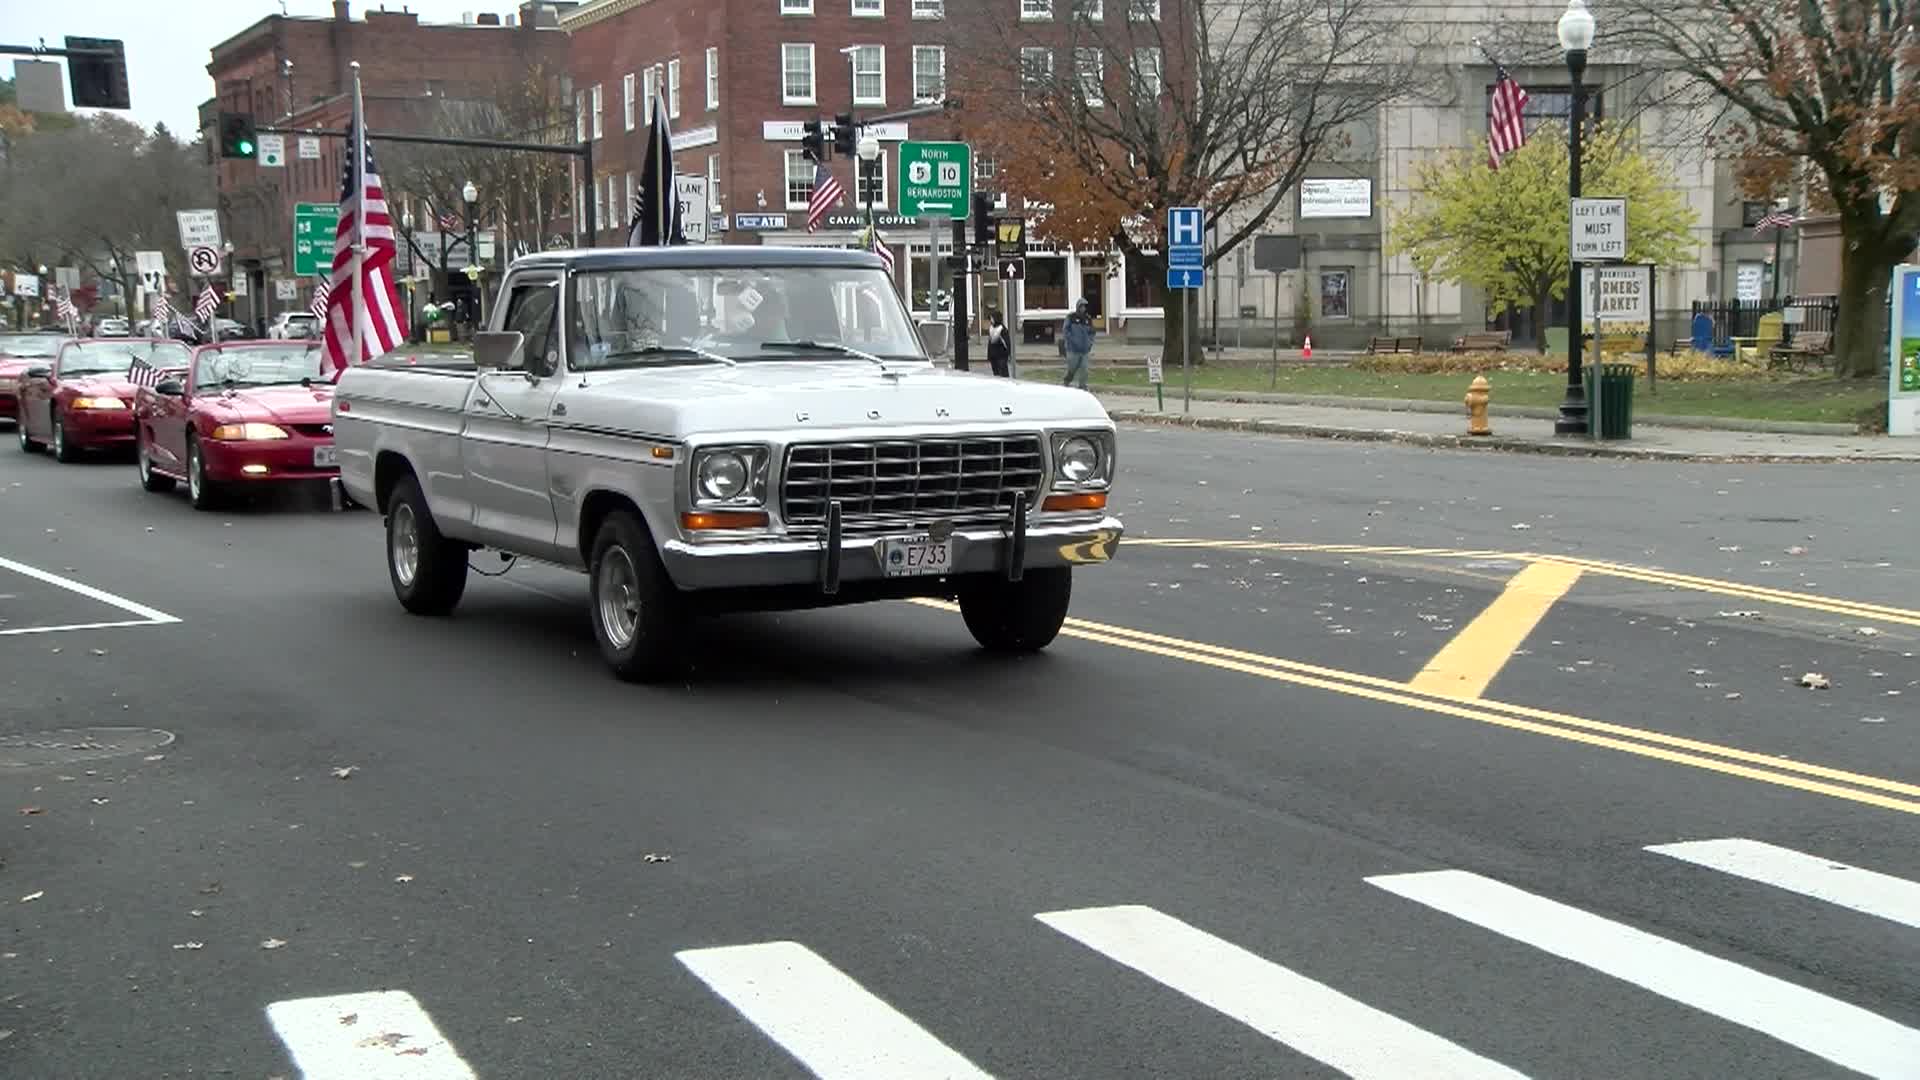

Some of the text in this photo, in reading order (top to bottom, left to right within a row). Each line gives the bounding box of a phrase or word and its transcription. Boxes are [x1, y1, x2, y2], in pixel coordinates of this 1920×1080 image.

[921, 149, 949, 159] NORTH
[916, 167, 957, 180] 5 10
[907, 187, 962, 199] BERNARDSTON
[1575, 205, 1622, 216] LEFT LANE
[761, 216, 785, 227] ATM
[879, 216, 916, 225] COFFEE
[1174, 211, 1198, 243] H
[1585, 223, 1611, 235] MUST
[1576, 241, 1622, 252] TURN LEFT
[1602, 297, 1639, 311] ARKET
[908, 545, 946, 566] E733
